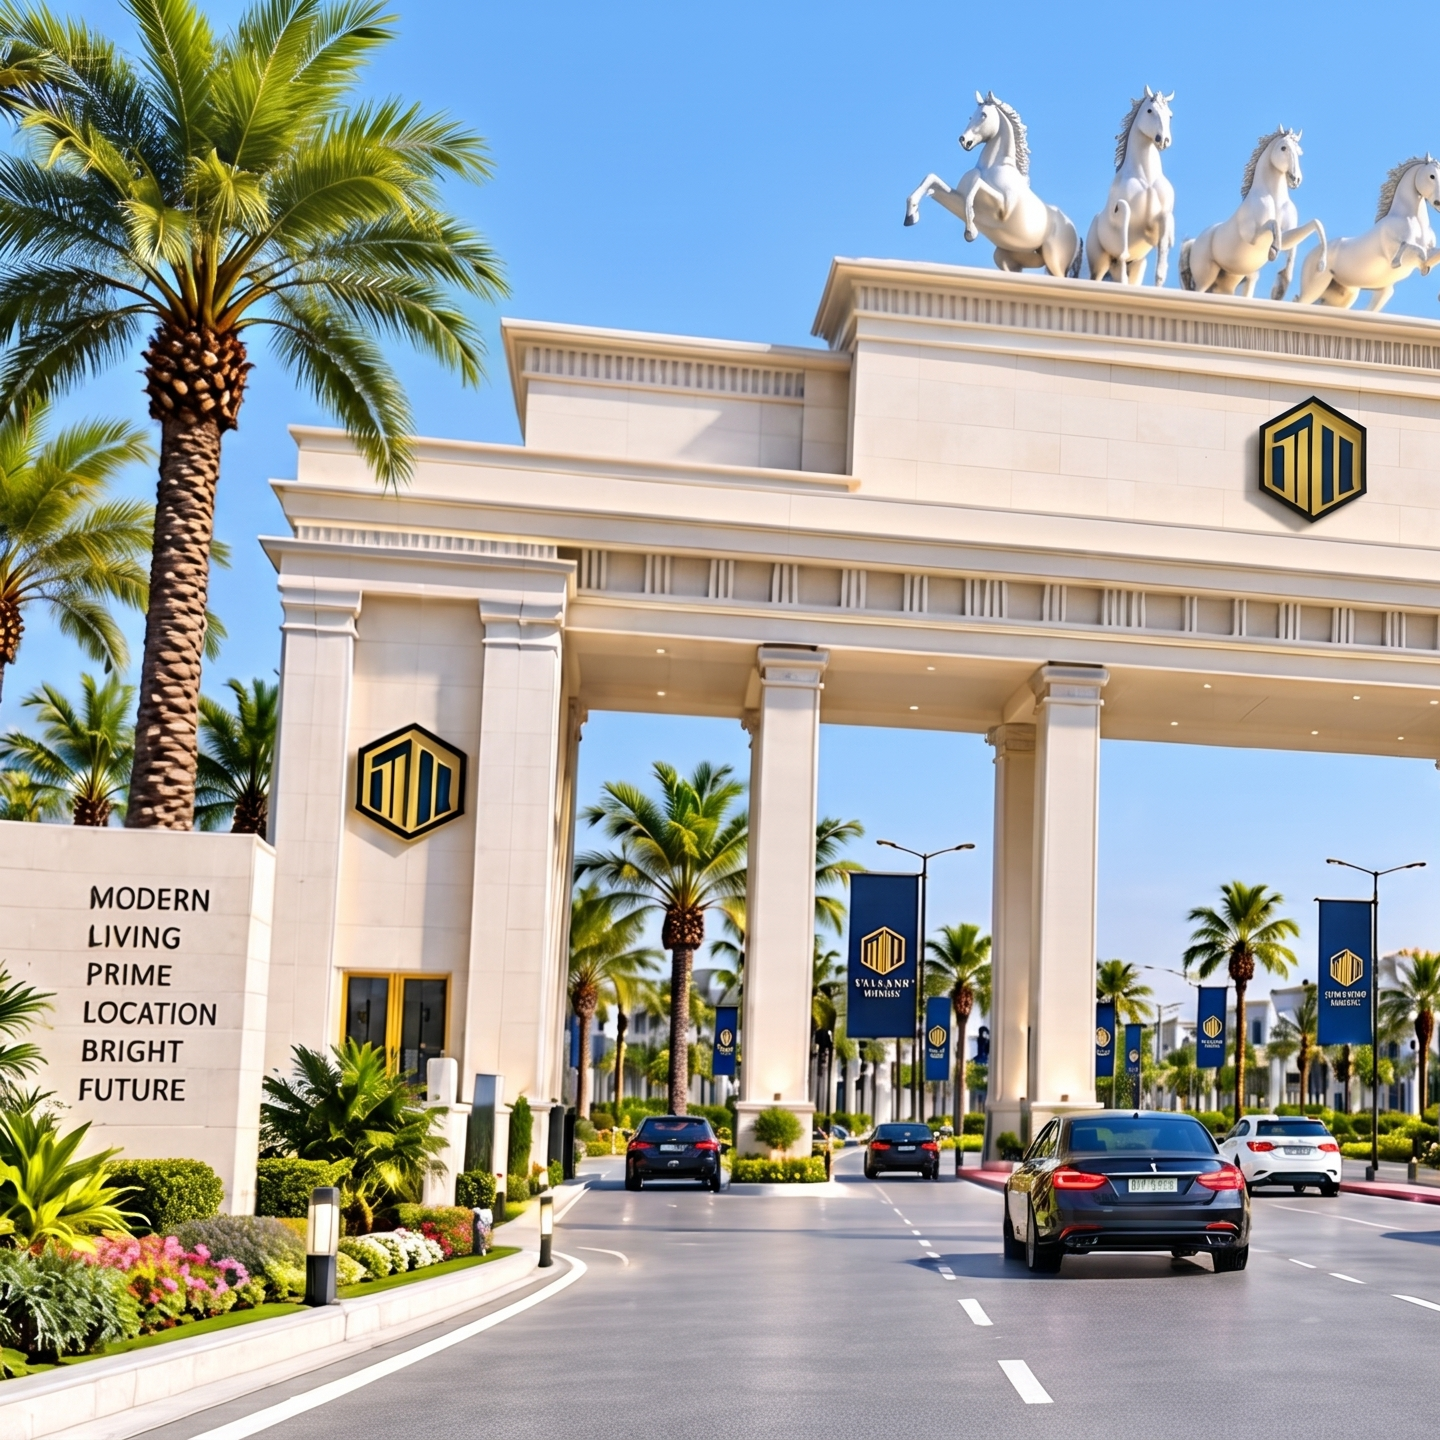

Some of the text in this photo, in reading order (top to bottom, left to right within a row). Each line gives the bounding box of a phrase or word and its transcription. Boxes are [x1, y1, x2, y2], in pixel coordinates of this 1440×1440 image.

[90, 885, 210, 912] MODERN
[88, 924, 181, 950] LIVING
[86, 962, 172, 987] PRIME
[83, 1000, 217, 1026] LOCATION
[81, 1039, 184, 1063] BRIGHT
[78, 1078, 186, 1102] FUTURE
